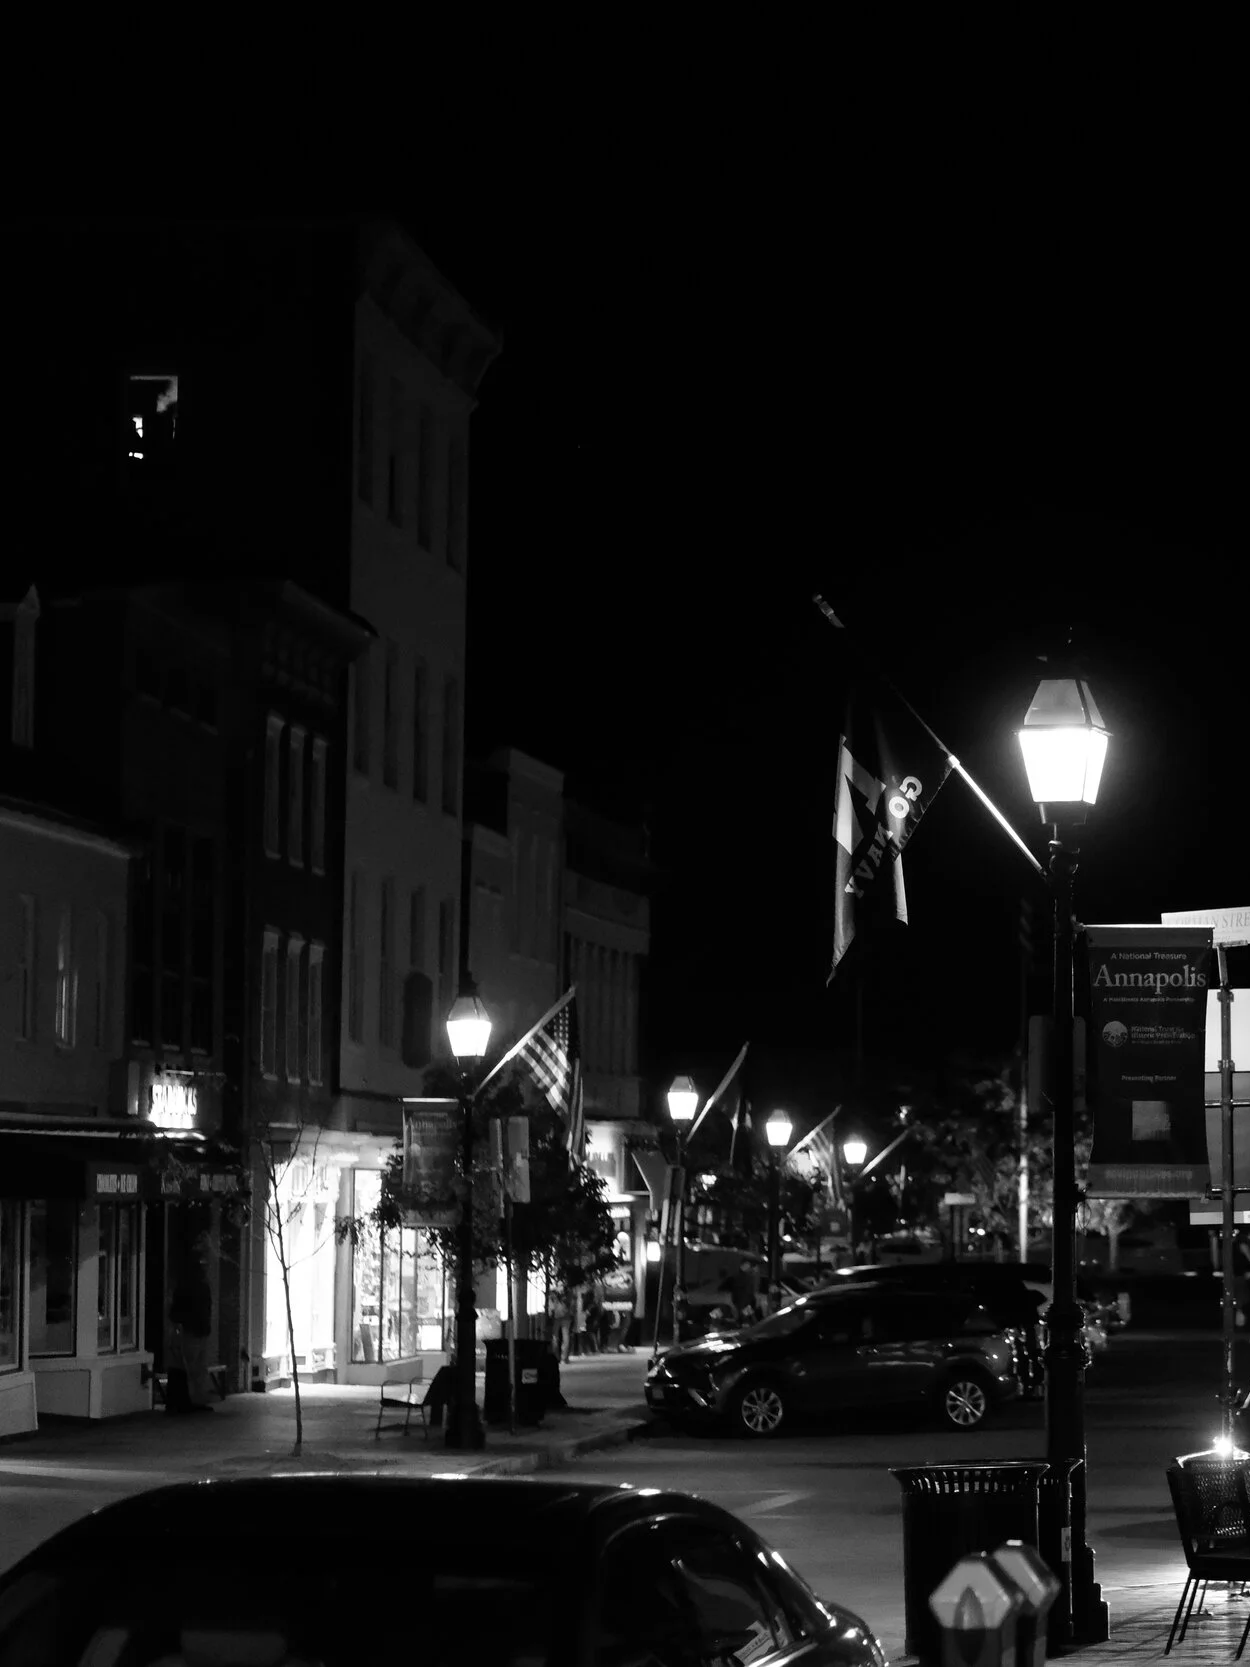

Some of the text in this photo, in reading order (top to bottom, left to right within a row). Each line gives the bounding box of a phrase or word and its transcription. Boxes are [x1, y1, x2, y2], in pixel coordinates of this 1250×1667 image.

[1166, 912, 1219, 928] ORMAN
[1110, 952, 1187, 960] A National Treasure
[1093, 963, 1207, 995] Annapolis
[1121, 1075, 1154, 1084] Presenting
